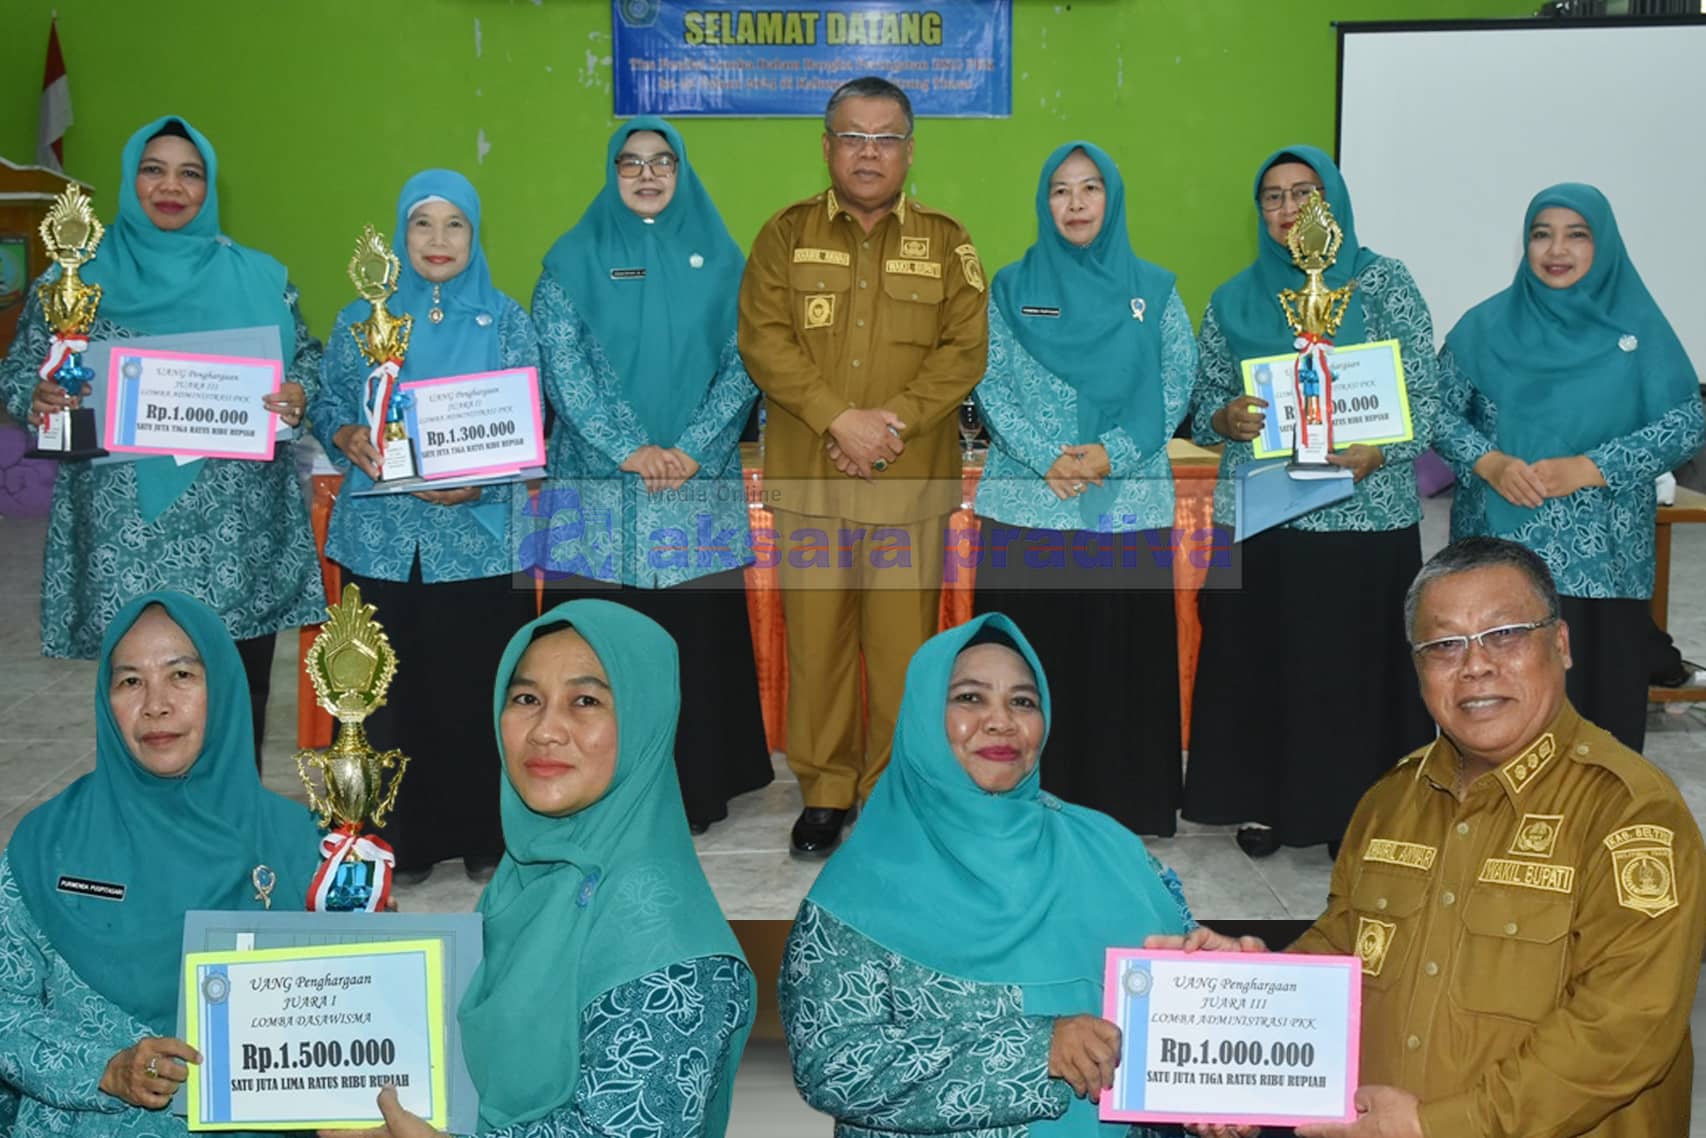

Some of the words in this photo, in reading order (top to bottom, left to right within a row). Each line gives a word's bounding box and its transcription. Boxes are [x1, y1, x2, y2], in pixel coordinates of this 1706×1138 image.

[684, 10, 819, 46] SELAMAT
[826, 11, 942, 46] DATANG
[146, 403, 249, 425] Rp.1.000.000
[427, 420, 516, 447] Rp.1.300.000
[1485, 862, 1521, 882] WAKIL
[1525, 865, 1570, 889] BUPATI
[250, 976, 292, 992] UANG
[295, 973, 372, 991] Penghargaan
[1173, 976, 1217, 993] UANG
[1221, 978, 1297, 995] Penghargaan
[282, 995, 328, 1010] JUARA
[331, 995, 337, 1006] I
[1200, 996, 1246, 1010] JUARA
[1250, 998, 1268, 1009] III
[251, 1015, 294, 1028] LOMBA
[295, 1012, 372, 1026] DASAWISMA
[1151, 1012, 1195, 1025] LOMBA
[1196, 1014, 1288, 1028] ADMINISTRASI
[1290, 1018, 1317, 1030] PKK
[242, 1038, 396, 1073] Rp.1.500.000
[1160, 1038, 1315, 1067] Rp.1.000.000
[232, 1078, 254, 1091] SATU
[256, 1077, 278, 1092] JUTA
[281, 1077, 304, 1090] LIMA
[308, 1076, 338, 1090] RATUS
[341, 1075, 367, 1088] RIBU
[370, 1074, 409, 1088] RUPIAH
[1147, 1071, 1170, 1083] SATU
[1172, 1072, 1195, 1084] JUTA
[1199, 1073, 1223, 1085] TIGA
[1226, 1073, 1257, 1086] RATUS
[1260, 1074, 1284, 1086] RIBU
[1287, 1075, 1326, 1088] RUPIAH
